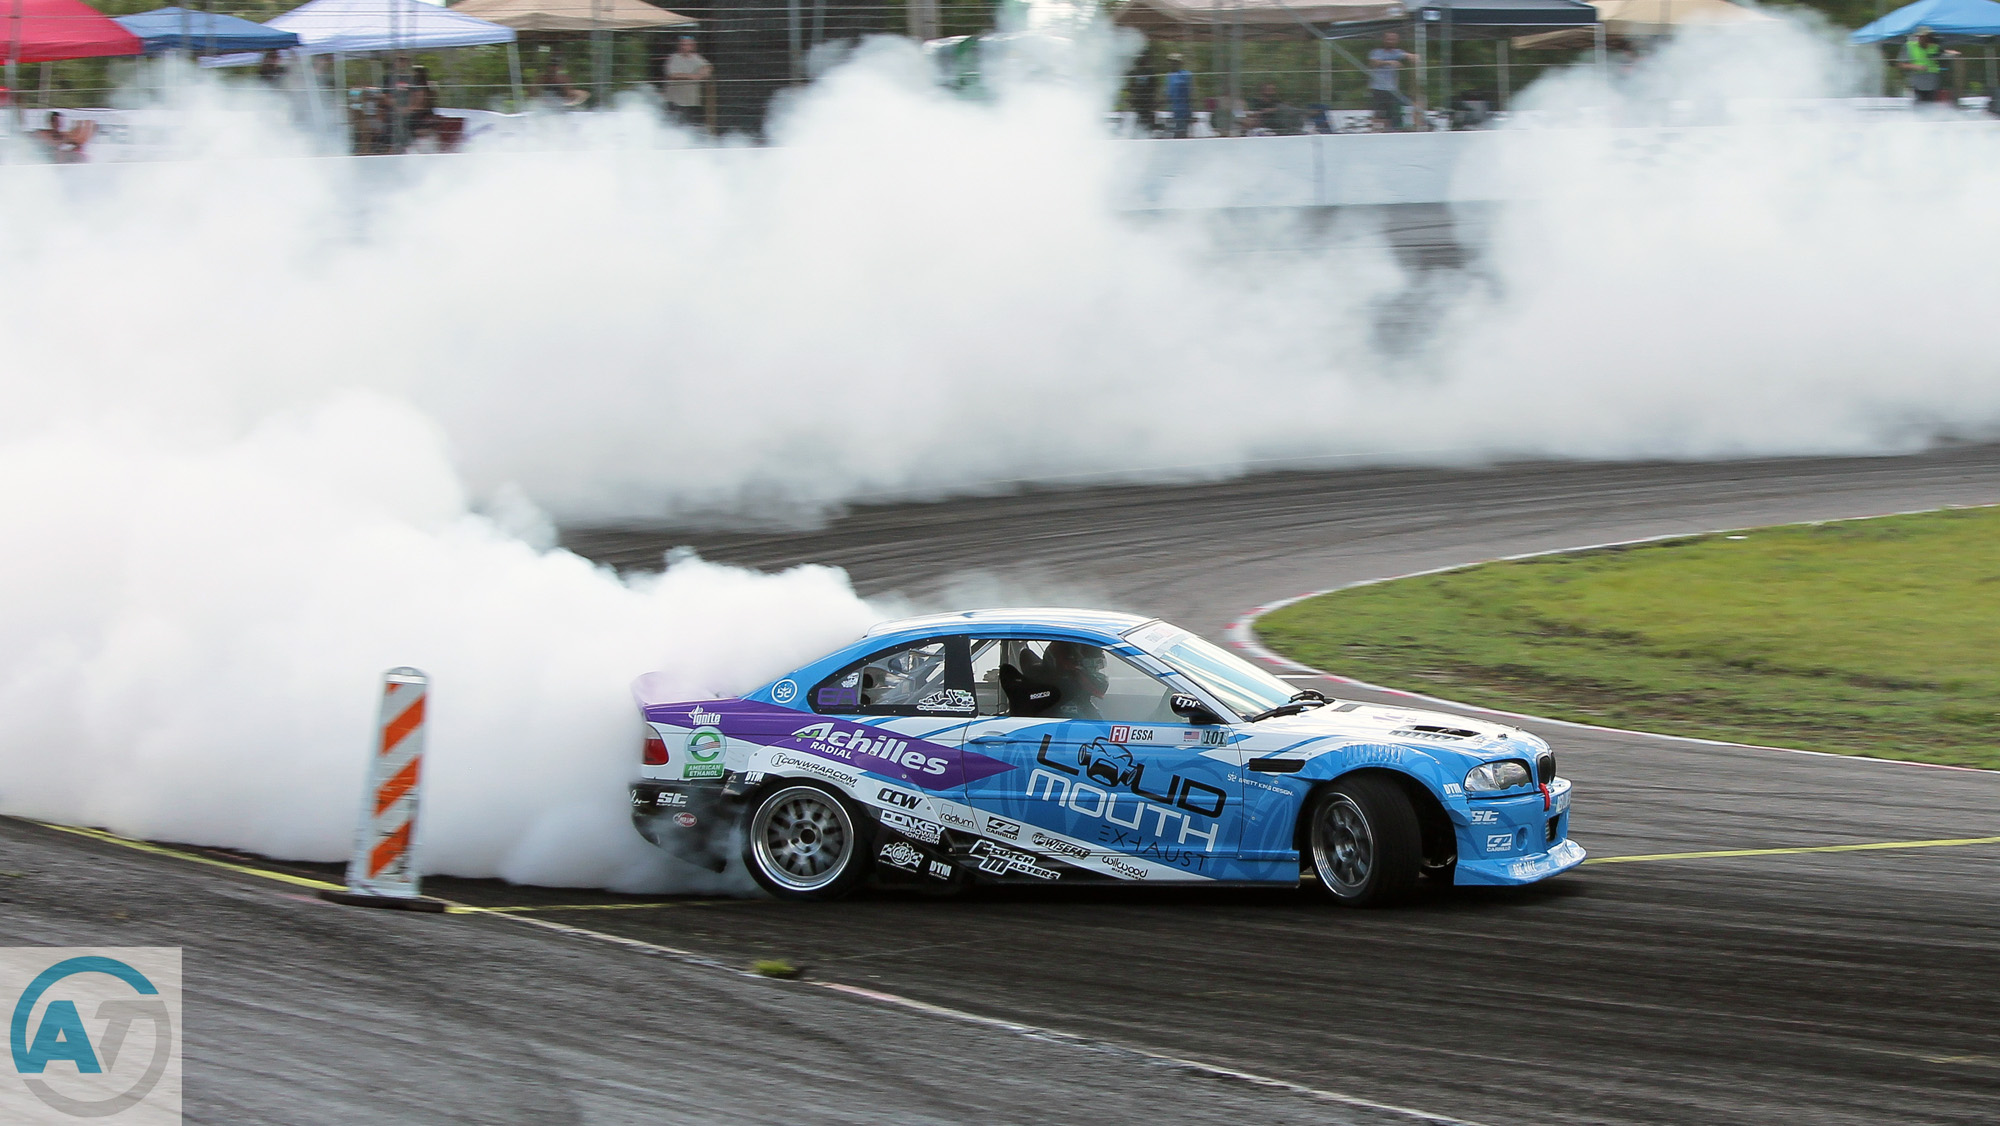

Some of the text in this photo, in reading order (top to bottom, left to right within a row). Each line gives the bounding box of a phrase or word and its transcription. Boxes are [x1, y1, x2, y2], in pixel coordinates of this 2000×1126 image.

[1112, 727, 1129, 742] FD
[1131, 729, 1226, 745] ESSA 101
[791, 722, 949, 775] Achilles
[810, 741, 852, 760] RADIAL
[745, 771, 764, 782] DTM
[1442, 783, 1462, 795] DTM
[877, 788, 922, 810] CCW
[1025, 768, 1219, 852] MOUTH
[880, 809, 946, 835] DONKEY
[941, 812, 975, 828] radium
[910, 827, 941, 841] POWER
[929, 860, 952, 876] DTM
[1101, 855, 1149, 878] wilwood
